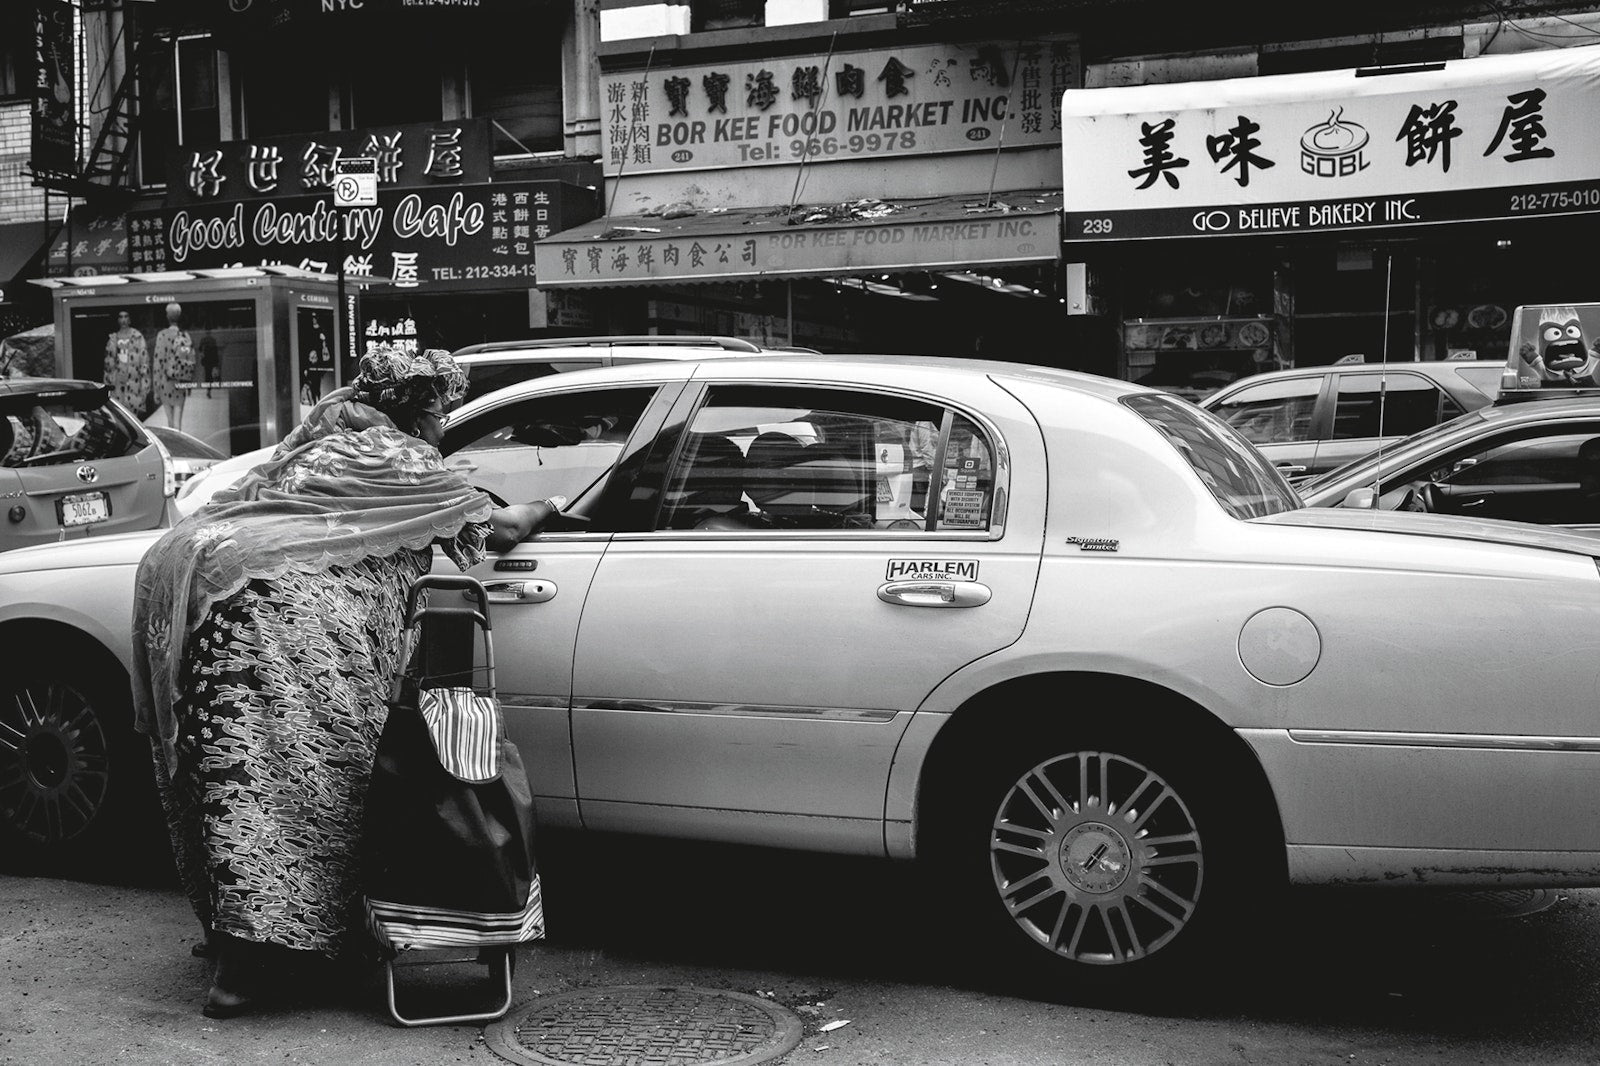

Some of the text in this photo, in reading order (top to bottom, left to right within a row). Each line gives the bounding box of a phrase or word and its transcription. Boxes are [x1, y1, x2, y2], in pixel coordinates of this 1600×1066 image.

[656, 95, 1016, 147] BOR KEE FOOD MARKET INC.
[969, 128, 988, 140] 241
[737, 131, 917, 162] Tel: 966-9978
[1127, 88, 1556, 190] 美味 餅屋
[672, 152, 691, 163] 241
[1301, 150, 1371, 178] GOBL
[169, 191, 485, 263] Good Century Cafe
[491, 192, 509, 255] 港式點心
[1083, 218, 1113, 234] 239
[1193, 199, 1421, 232] GO BELIEVE BAKERY INC.
[769, 220, 1037, 249] BOR KEE FOOD MARKET INC.
[562, 239, 758, 276] 寶寶海鮮肉食公司
[432, 267, 462, 280] TEL:
[348, 295, 358, 358] Newsstand
[1065, 536, 1119, 546] Signature
[1081, 543, 1118, 552] Limited
[889, 561, 975, 579] HARLEM
